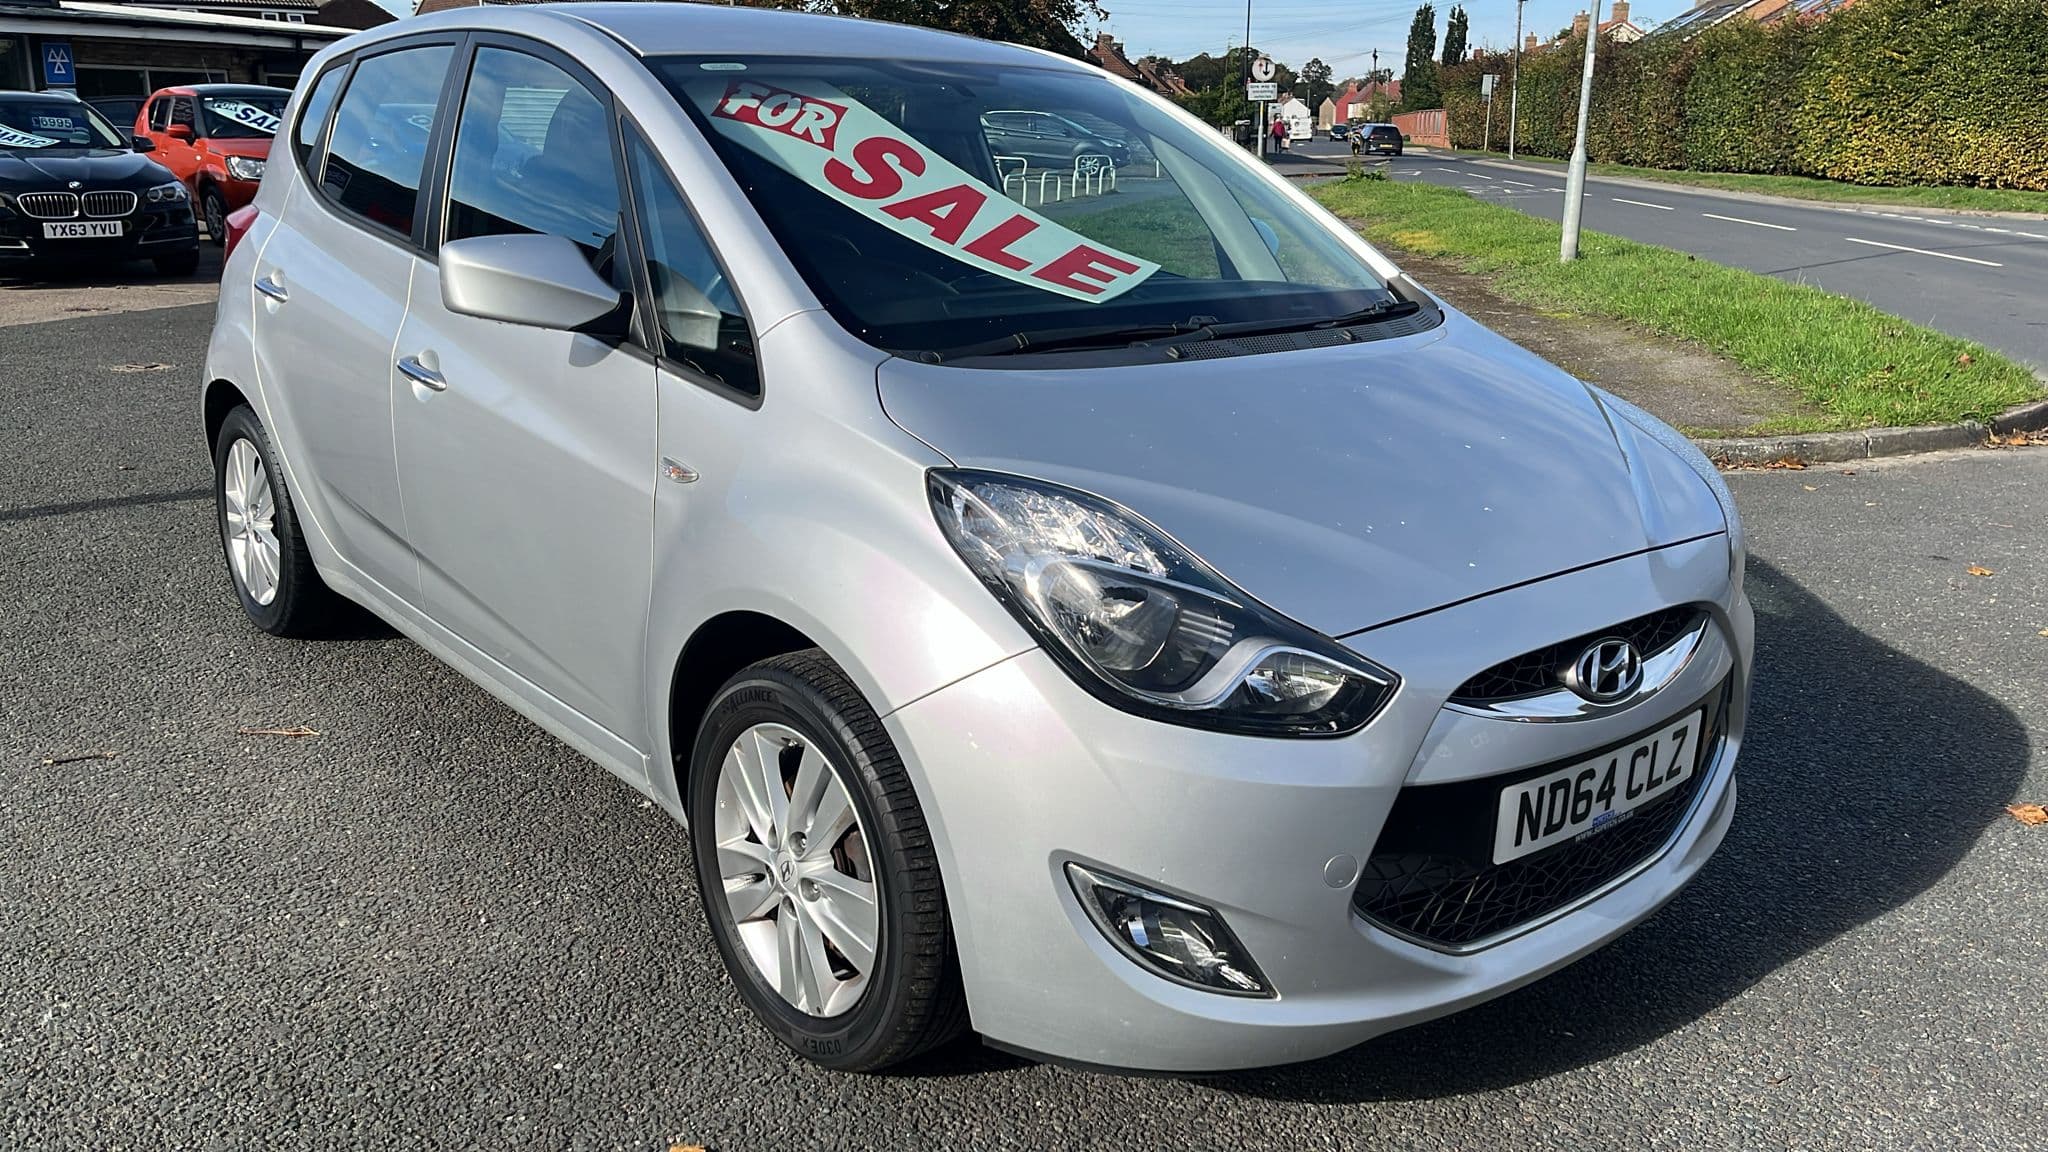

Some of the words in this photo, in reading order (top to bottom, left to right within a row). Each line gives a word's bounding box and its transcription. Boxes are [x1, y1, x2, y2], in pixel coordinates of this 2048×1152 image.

[50, 225, 87, 236] YX63
[90, 224, 117, 234] YVU
[720, 82, 838, 144] FOR
[823, 136, 1140, 295] SALE
[1514, 758, 1617, 848] ND64
[1626, 725, 1689, 800] CLZ
